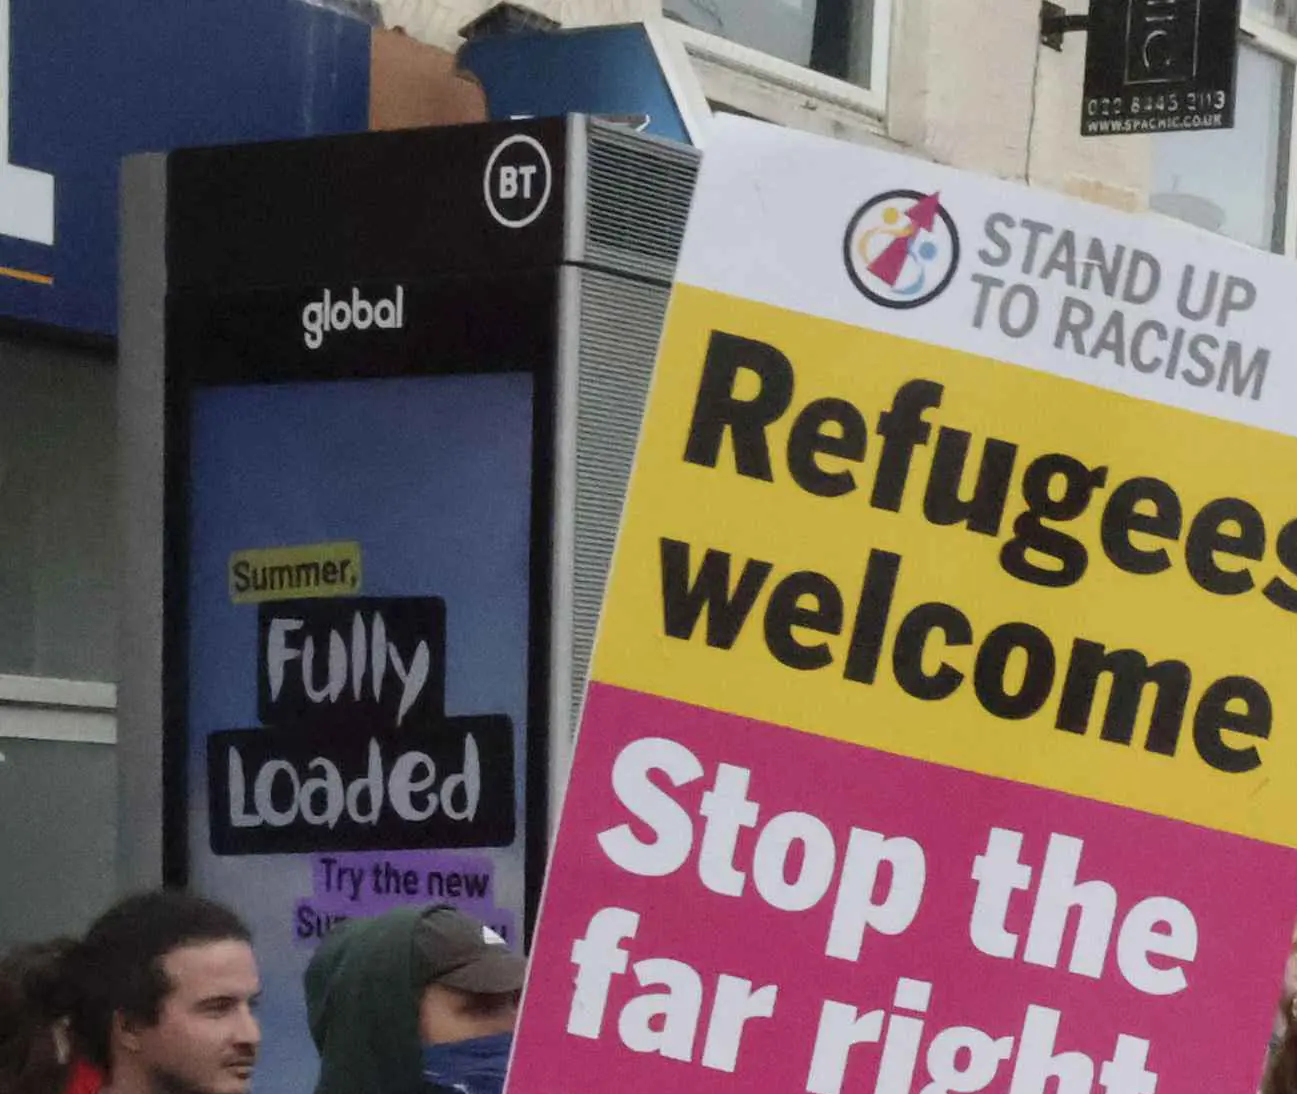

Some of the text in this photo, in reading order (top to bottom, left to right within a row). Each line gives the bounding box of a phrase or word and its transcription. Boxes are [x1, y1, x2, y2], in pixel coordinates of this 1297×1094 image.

[500, 165, 536, 198] BT
[302, 286, 404, 349] global
[977, 211, 1257, 330] STAND UP
[970, 273, 1271, 401] TO RACISM
[231, 556, 358, 596] Summer,
[265, 611, 431, 725] Fully
[659, 537, 1273, 774] welcome
[228, 732, 481, 831] Loaded
[320, 857, 490, 900] Try the new
[597, 736, 1198, 996] Stop the
[566, 906, 778, 1073] far
